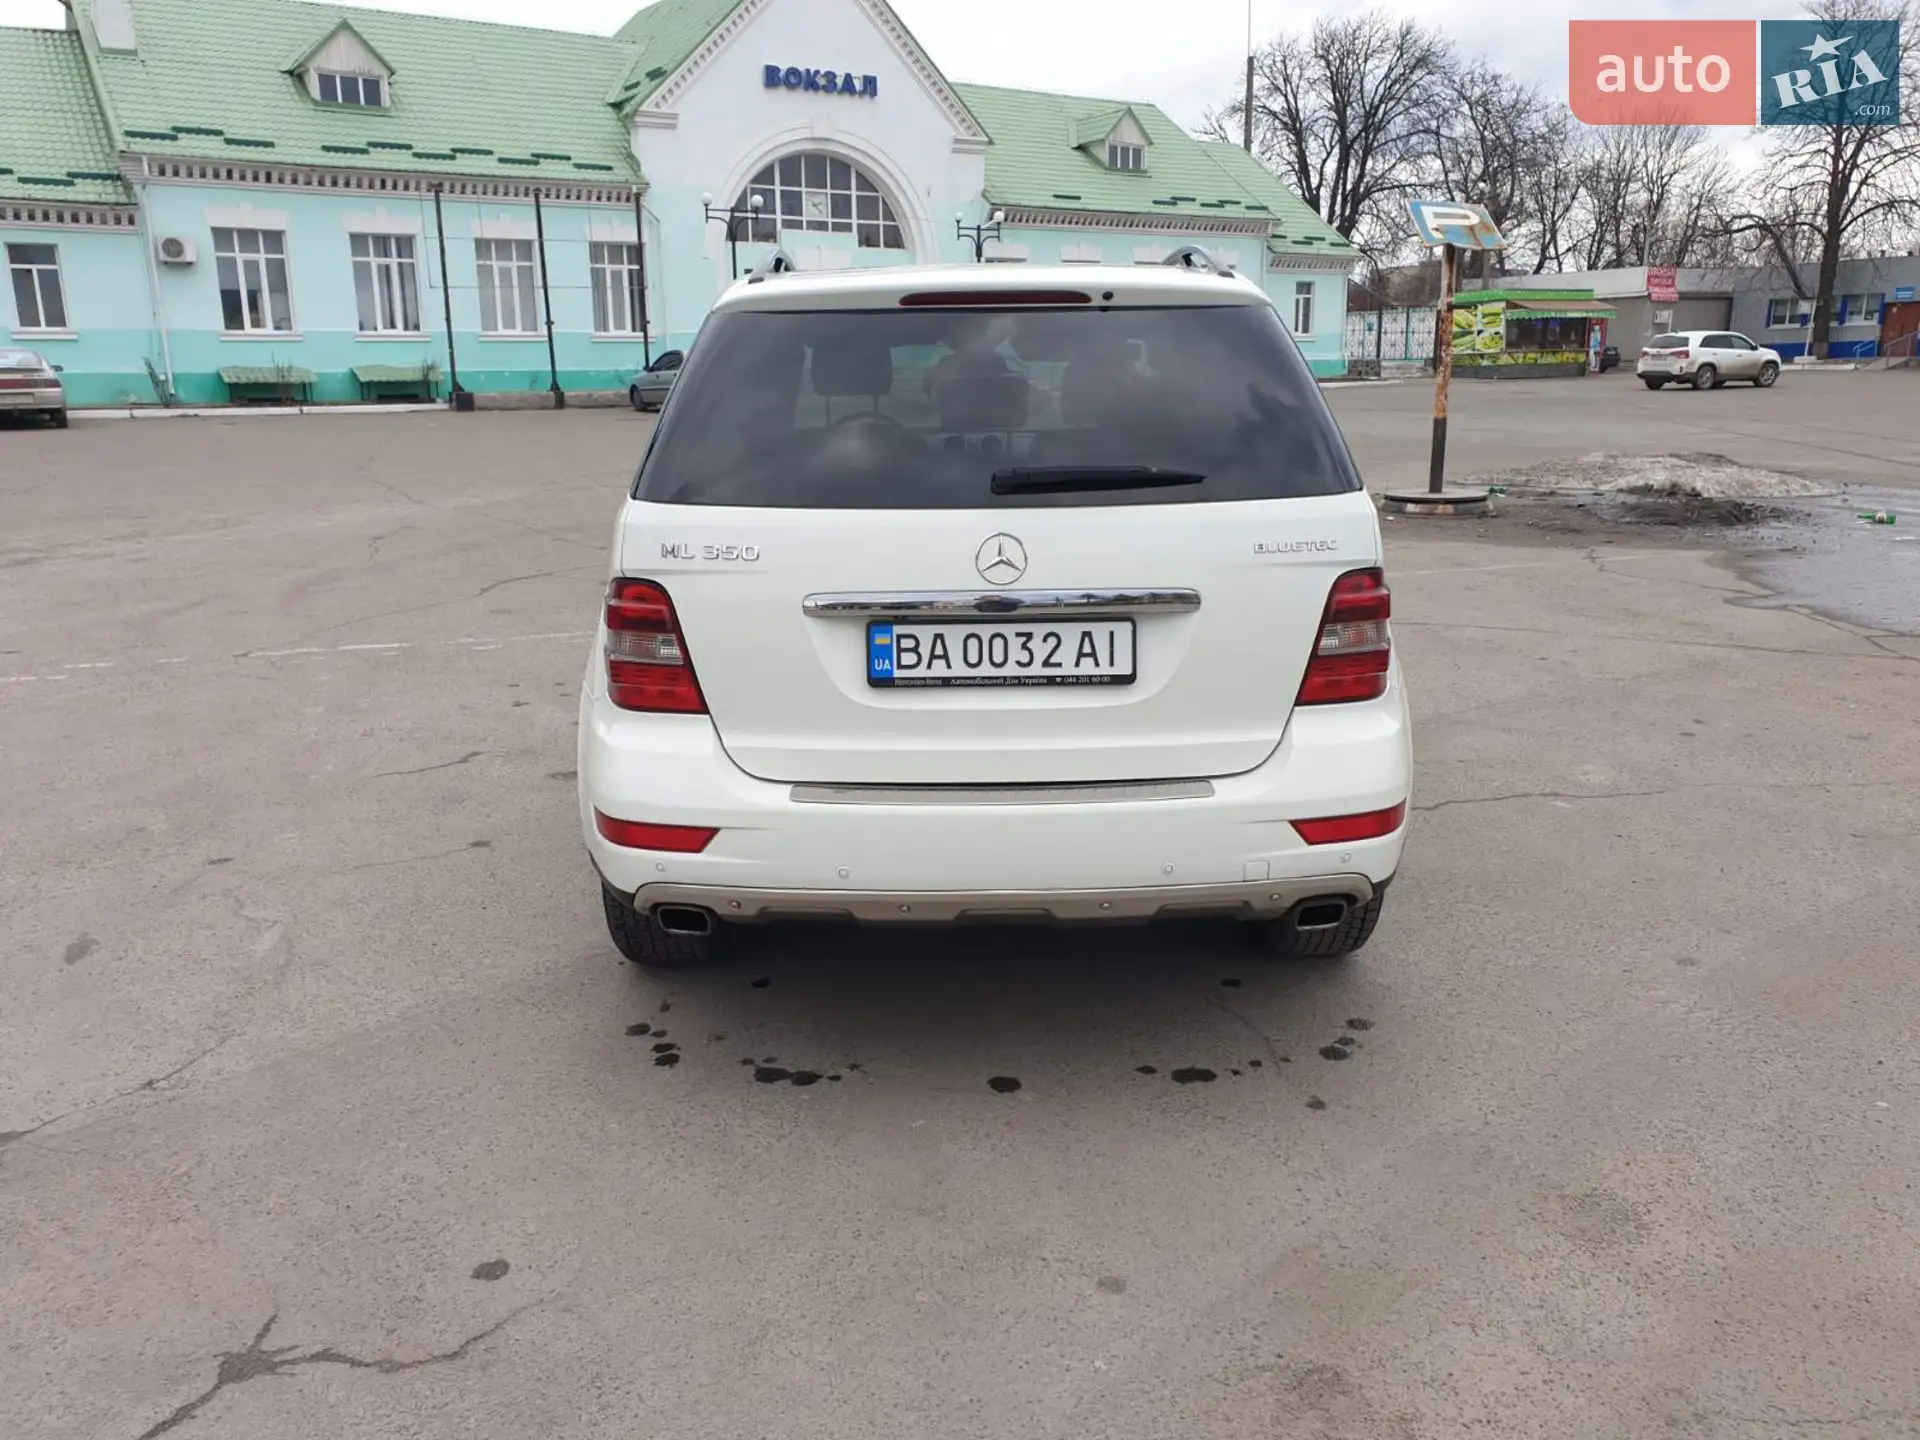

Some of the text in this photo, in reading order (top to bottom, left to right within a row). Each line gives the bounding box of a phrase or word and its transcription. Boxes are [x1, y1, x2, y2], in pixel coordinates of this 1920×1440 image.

[763, 64, 878, 99] ВОКЗАЛ
[1420, 205, 1480, 239] P
[661, 541, 760, 561] ML 350
[1253, 540, 1339, 554] BLUETEC
[896, 630, 1114, 670] BA 0032 AI
[875, 658, 891, 670] UA
